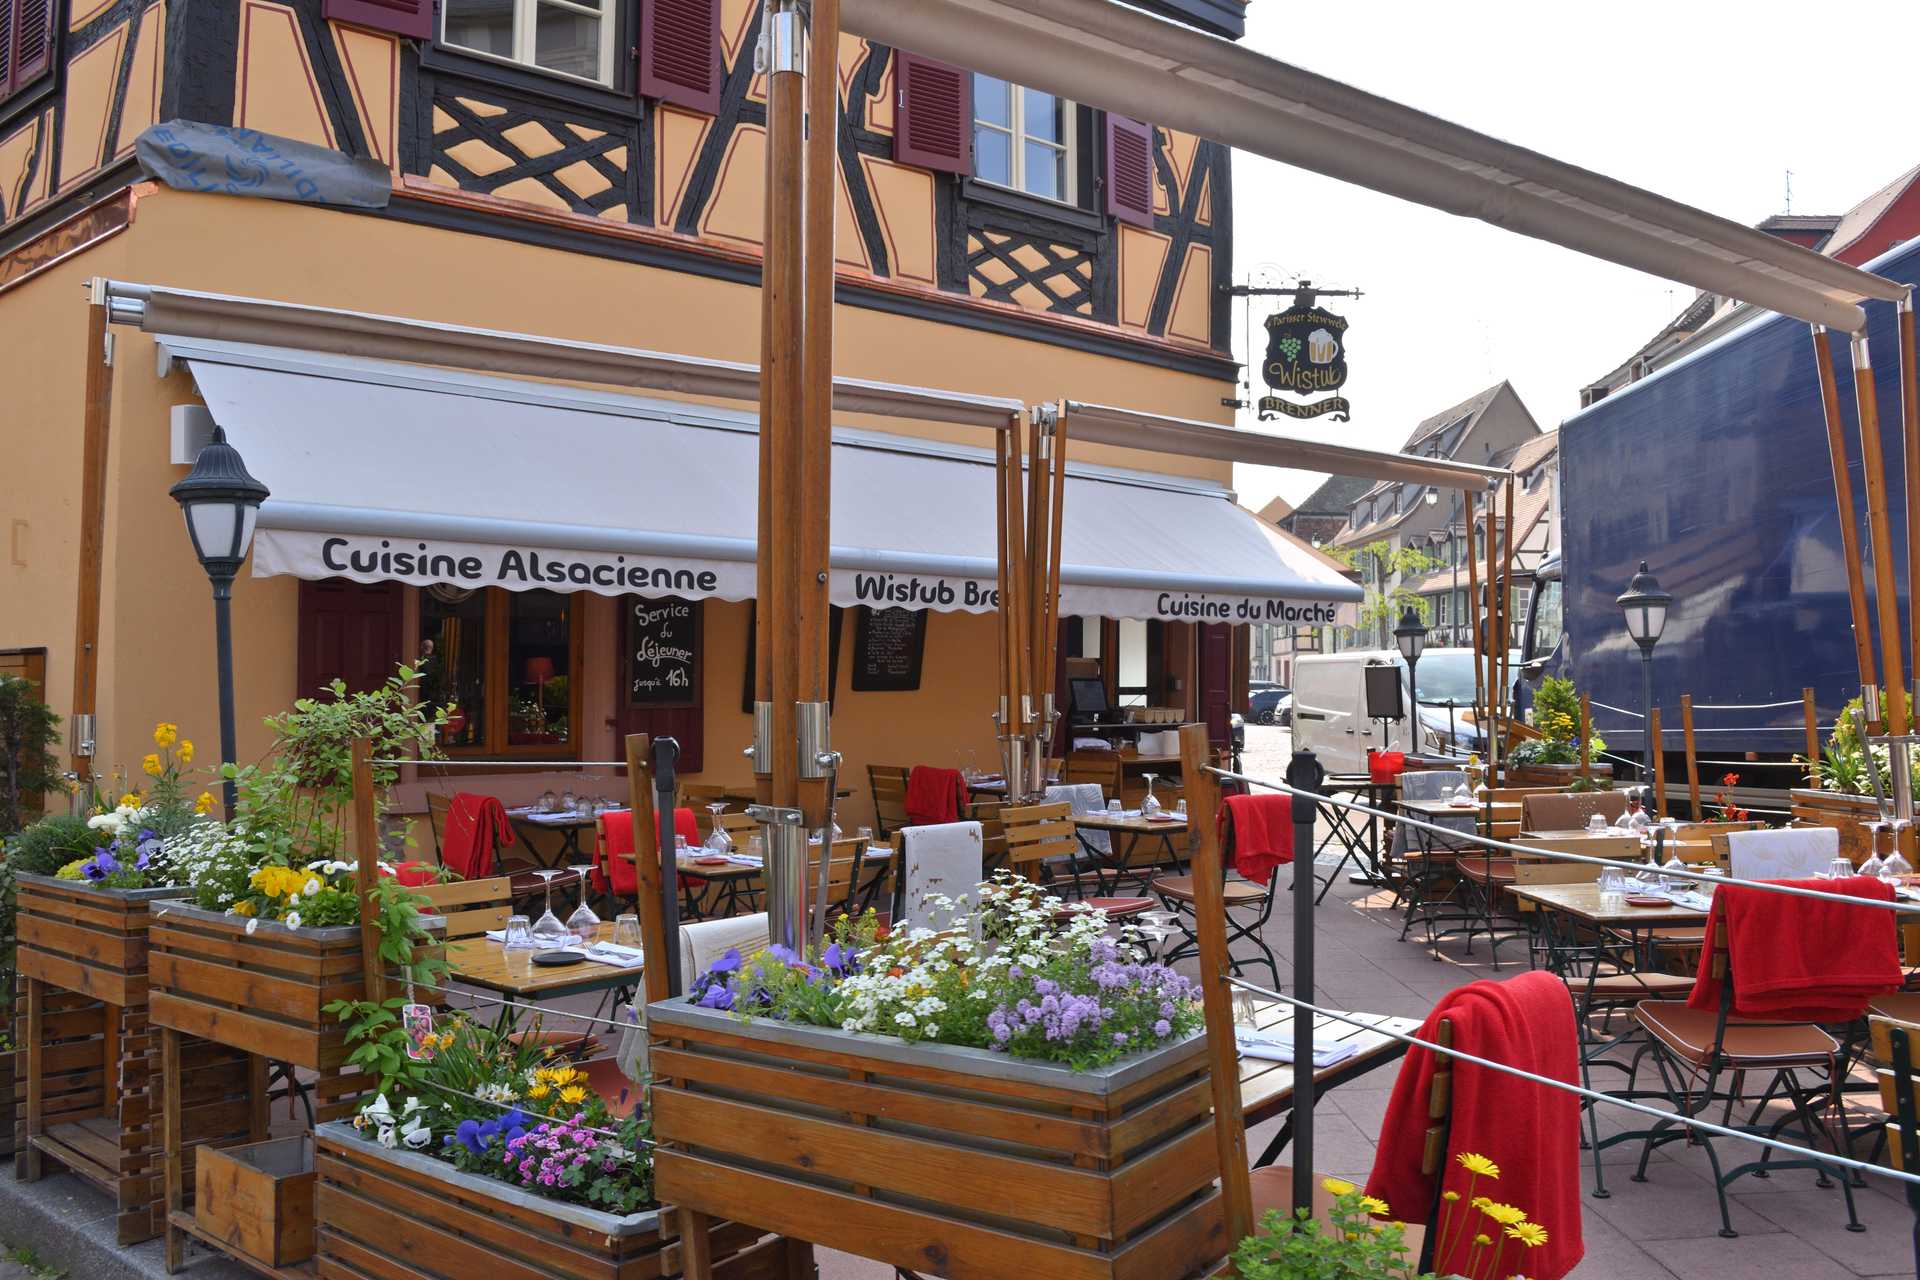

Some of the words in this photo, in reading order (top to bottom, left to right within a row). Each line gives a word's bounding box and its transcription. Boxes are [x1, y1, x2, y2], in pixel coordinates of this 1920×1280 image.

[1268, 360, 1342, 390] Wistub
[1265, 397, 1344, 417] BRENNER
[322, 537, 483, 580] Cuisine
[496, 549, 718, 592] Alsacienne
[855, 573, 955, 605] Wistub
[635, 603, 690, 626] Service
[1157, 593, 1230, 618] Cuisine
[1237, 598, 1261, 620] du
[1265, 600, 1336, 623] Marché
[660, 622, 673, 638] du
[636, 636, 693, 668] déjeuner
[665, 667, 689, 687] 16h
